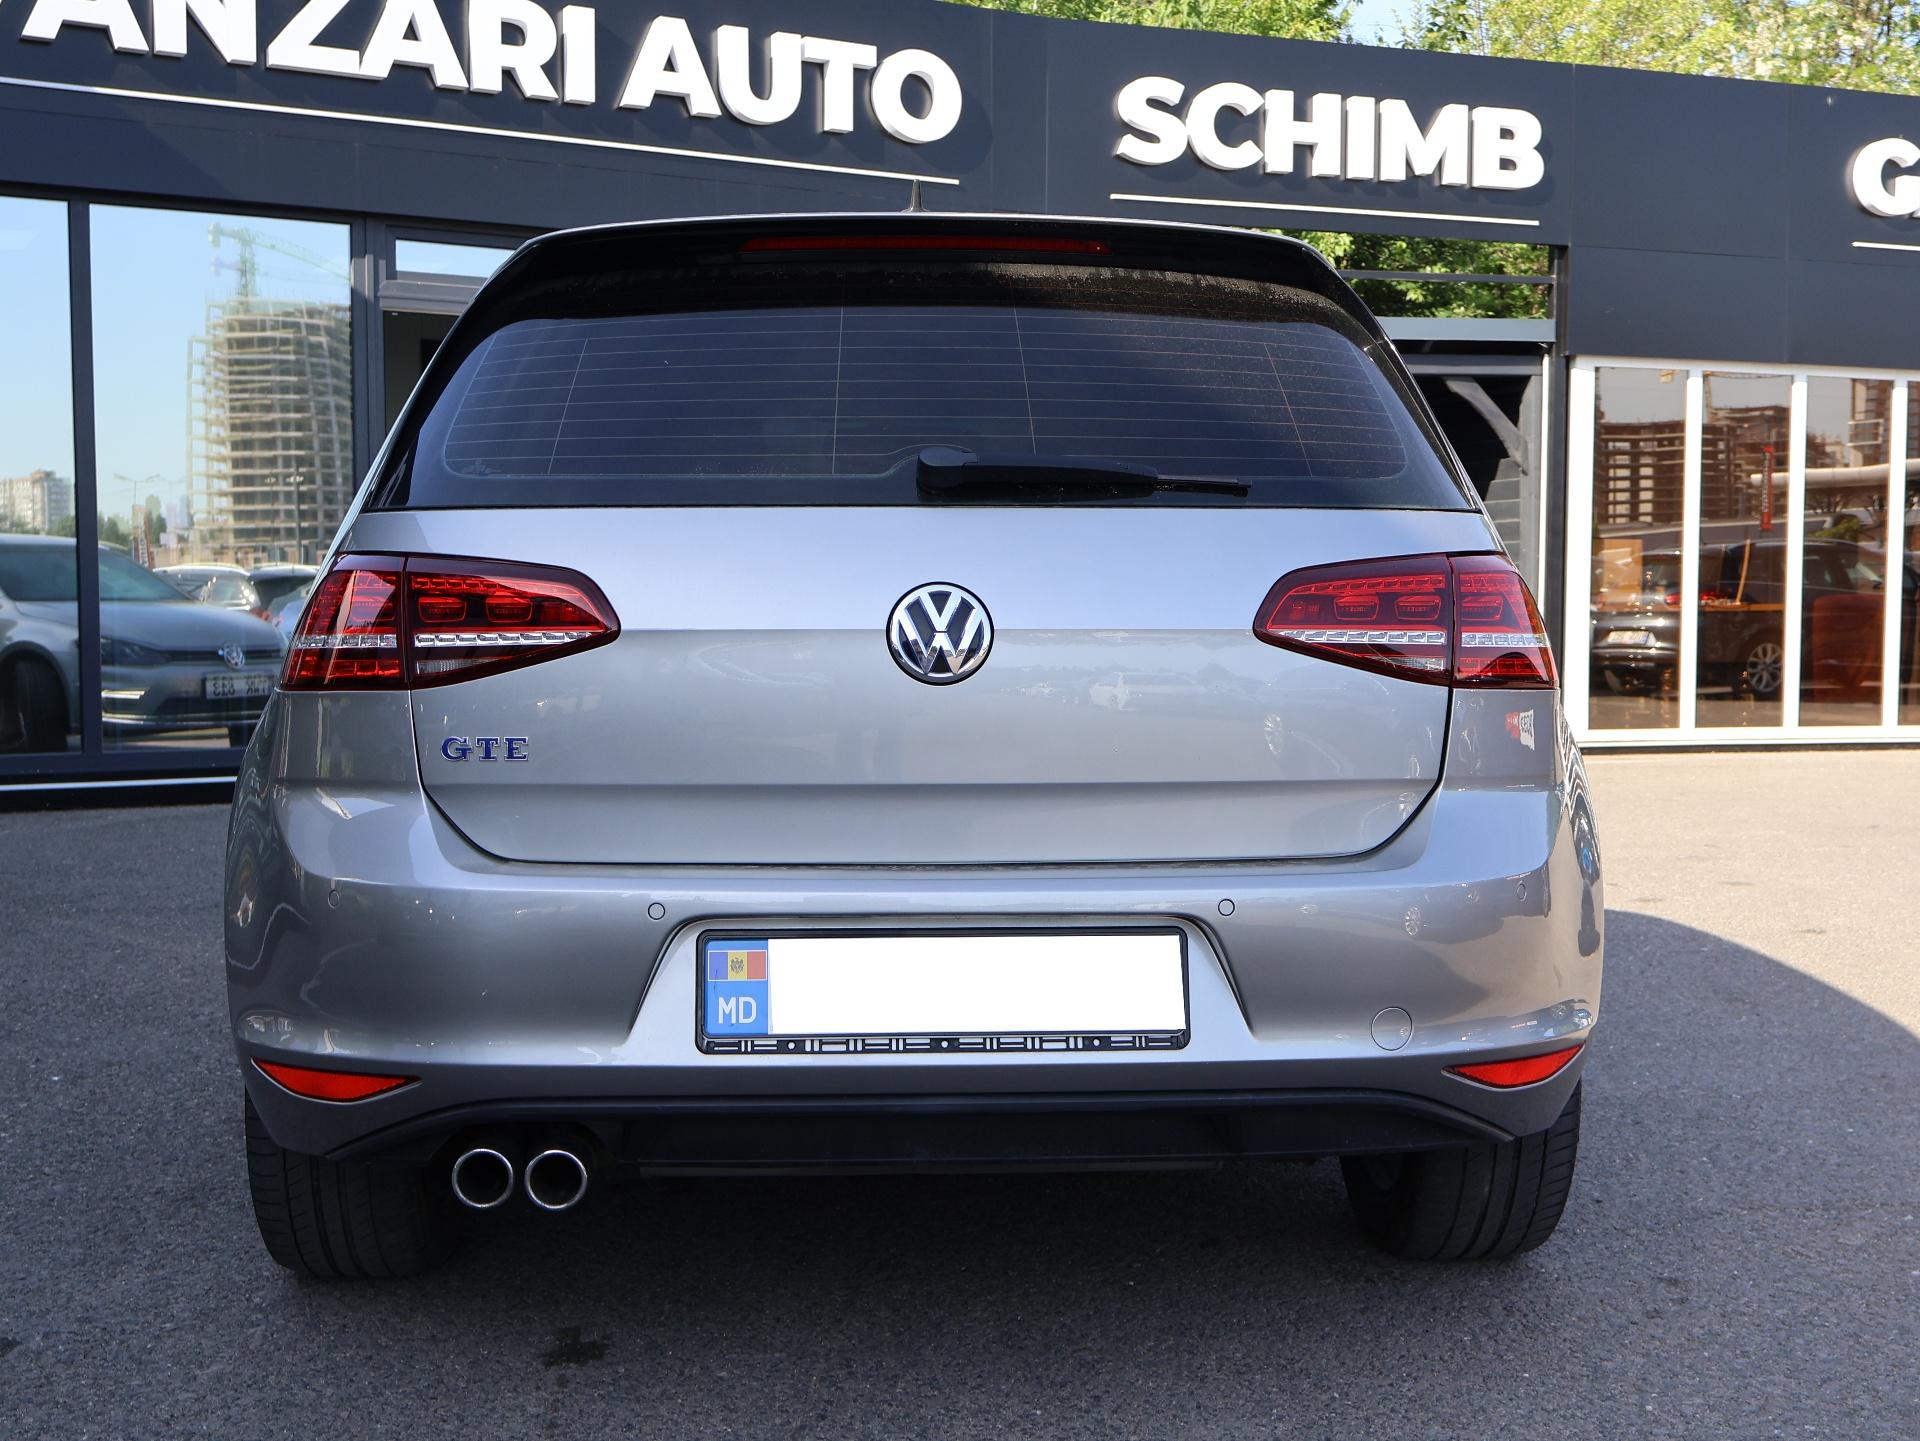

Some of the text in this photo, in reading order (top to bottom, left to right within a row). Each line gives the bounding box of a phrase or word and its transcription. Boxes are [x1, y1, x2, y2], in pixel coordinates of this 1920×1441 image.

[0, 0, 963, 144] ANZARI AUTO
[1115, 76, 1546, 190] SCHIMB
[1850, 137, 1920, 218] G
[441, 736, 529, 761] GTE
[718, 996, 757, 1024] MD
